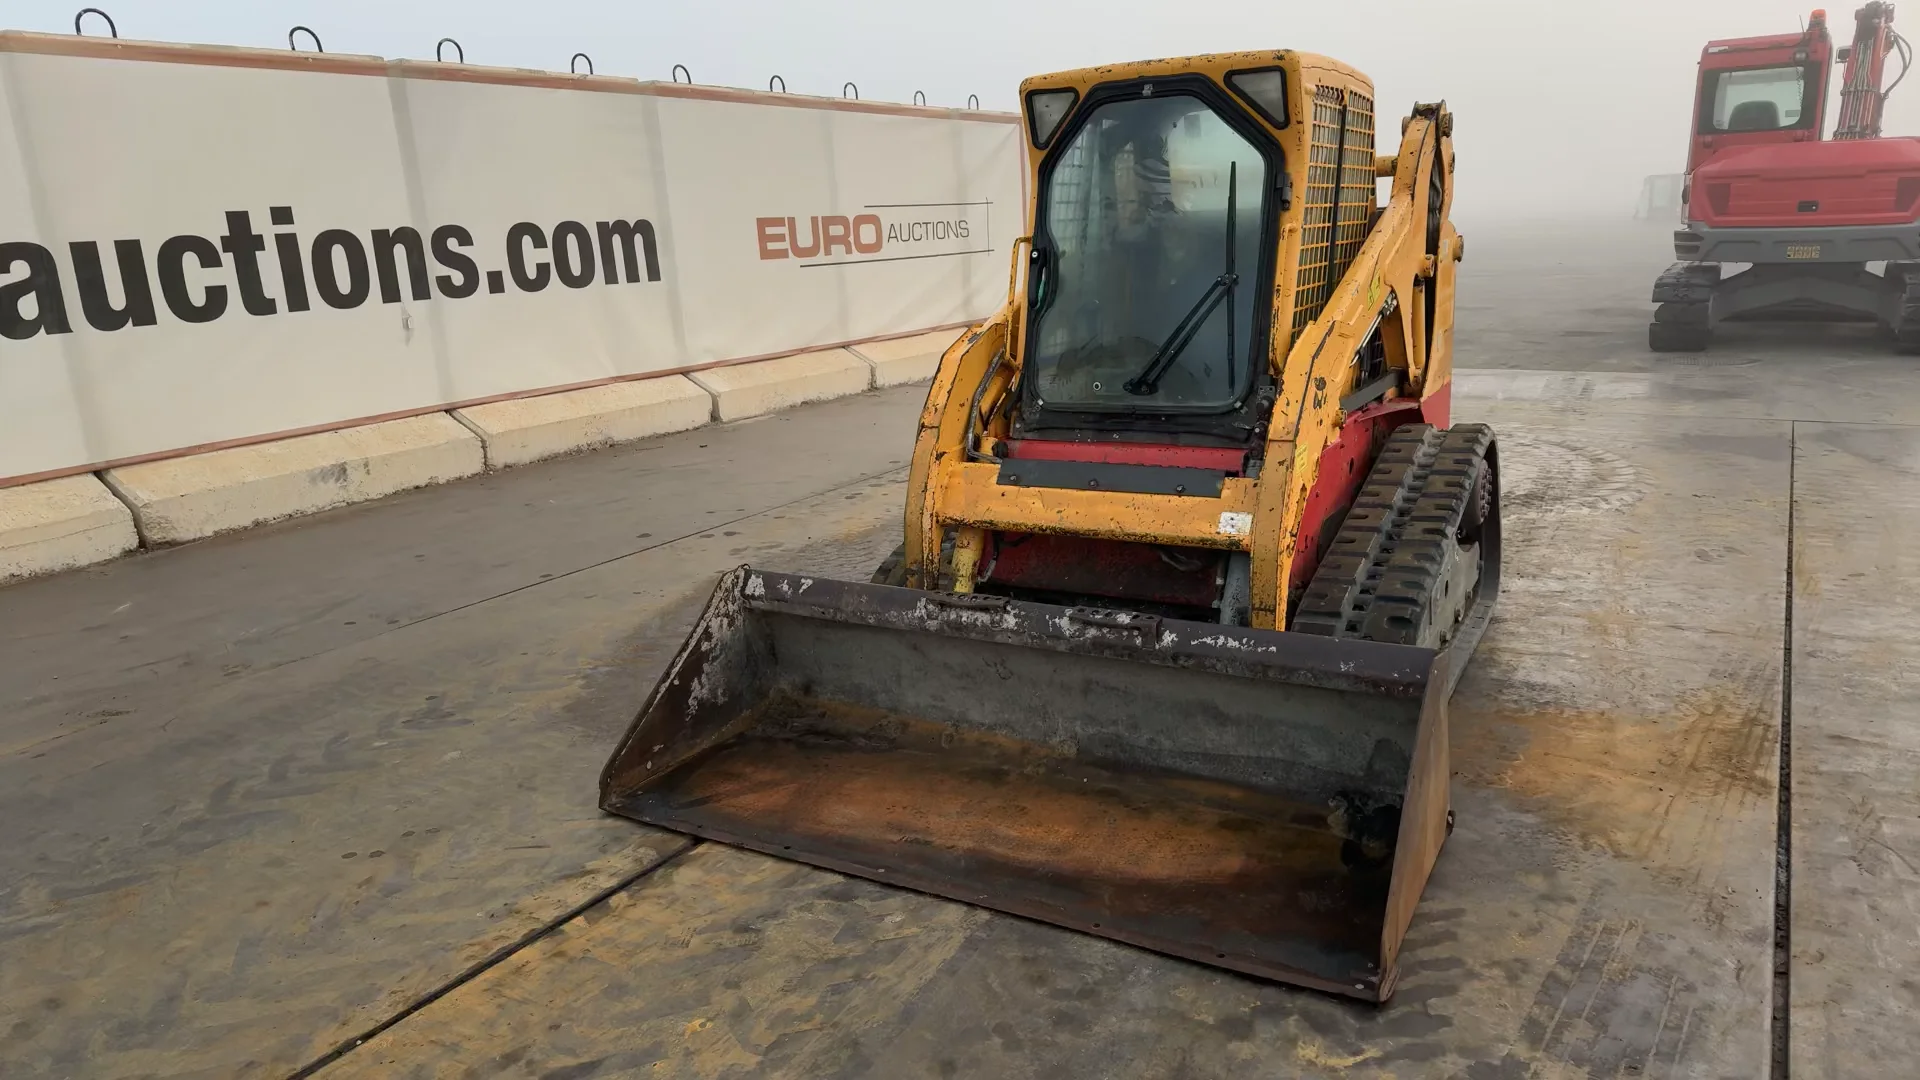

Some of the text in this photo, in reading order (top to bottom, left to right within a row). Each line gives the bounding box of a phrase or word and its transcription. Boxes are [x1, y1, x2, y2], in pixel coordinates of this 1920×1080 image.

[0, 206, 661, 340] auctions.com
[756, 214, 970, 260] EURO AUCTIONS
